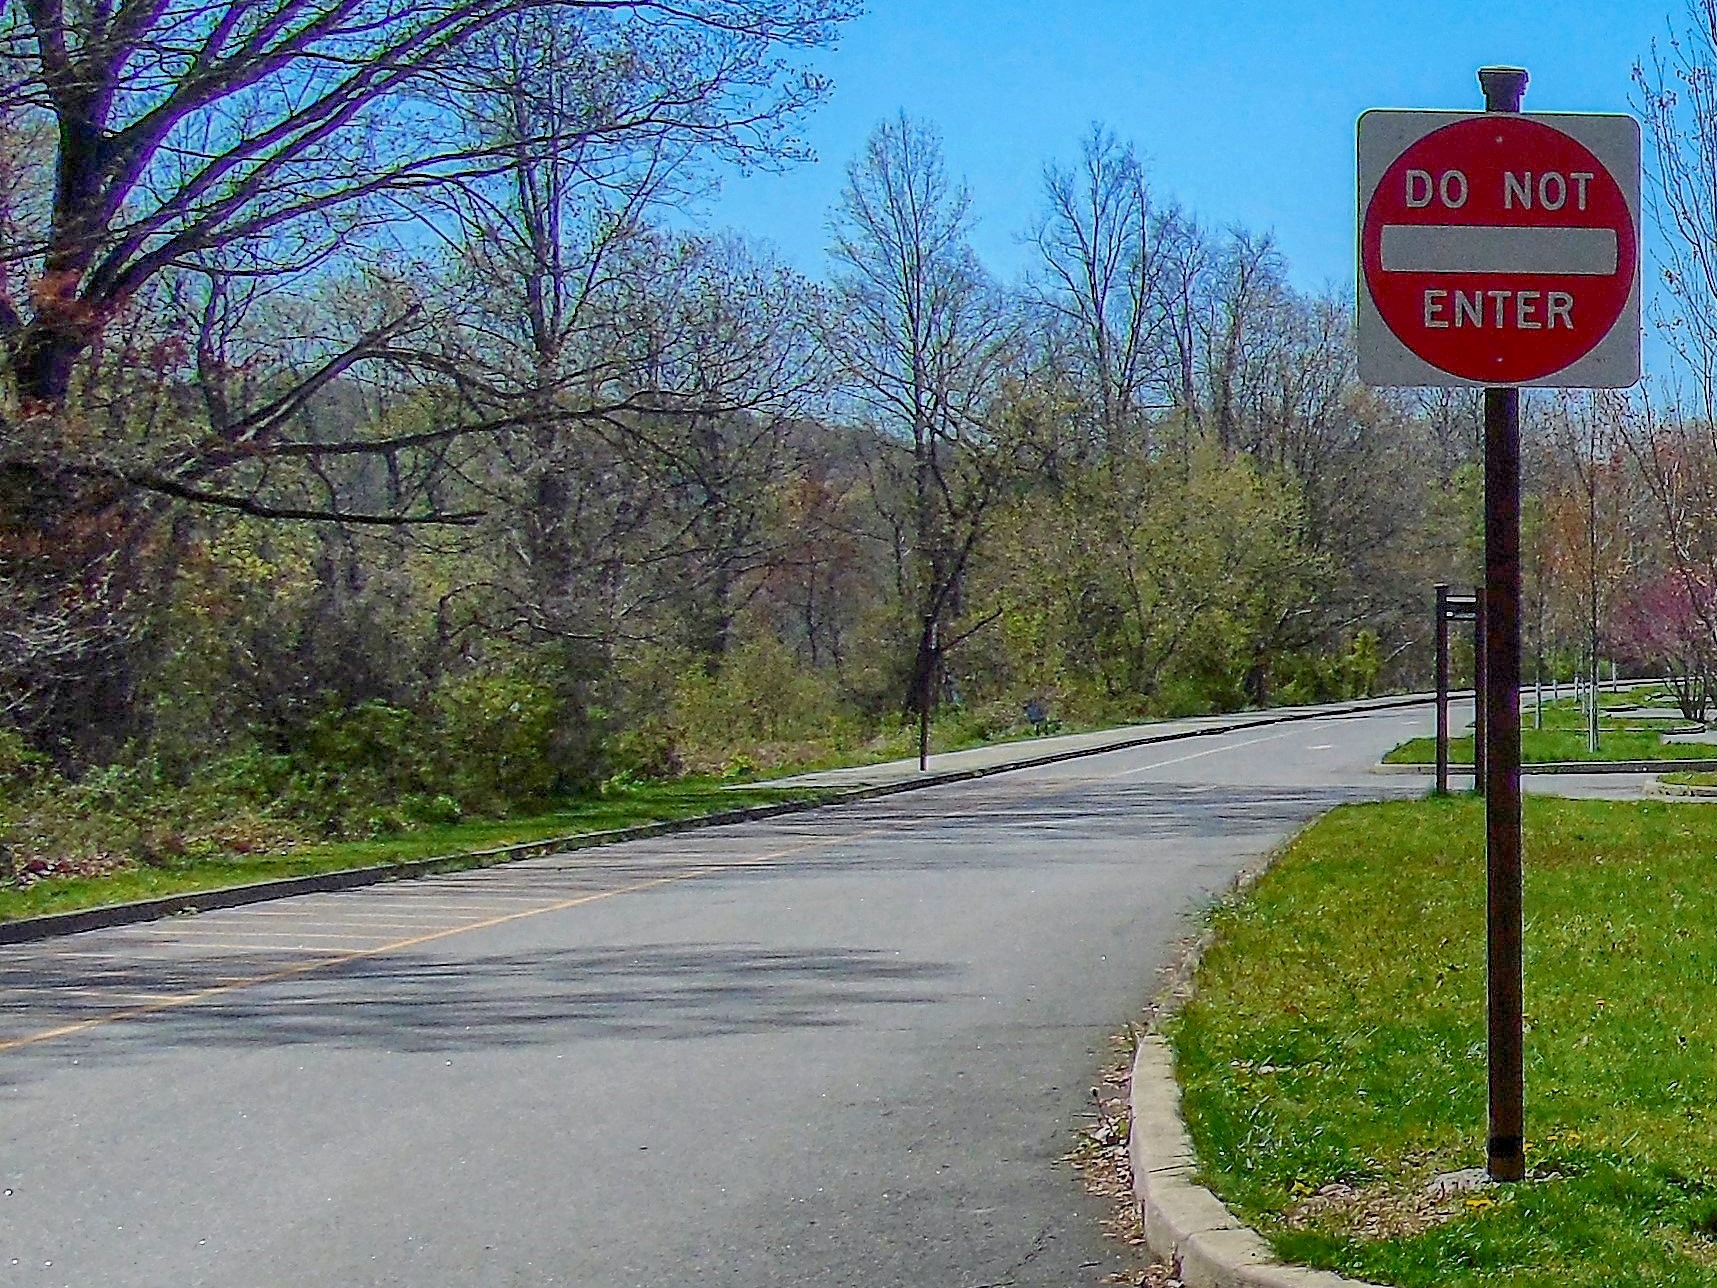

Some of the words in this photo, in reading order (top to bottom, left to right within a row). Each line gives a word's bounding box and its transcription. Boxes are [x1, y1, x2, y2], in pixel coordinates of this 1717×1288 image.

[1406, 169, 1468, 209] DO
[1504, 171, 1594, 211] NOT
[1424, 289, 1574, 330] ENTER
